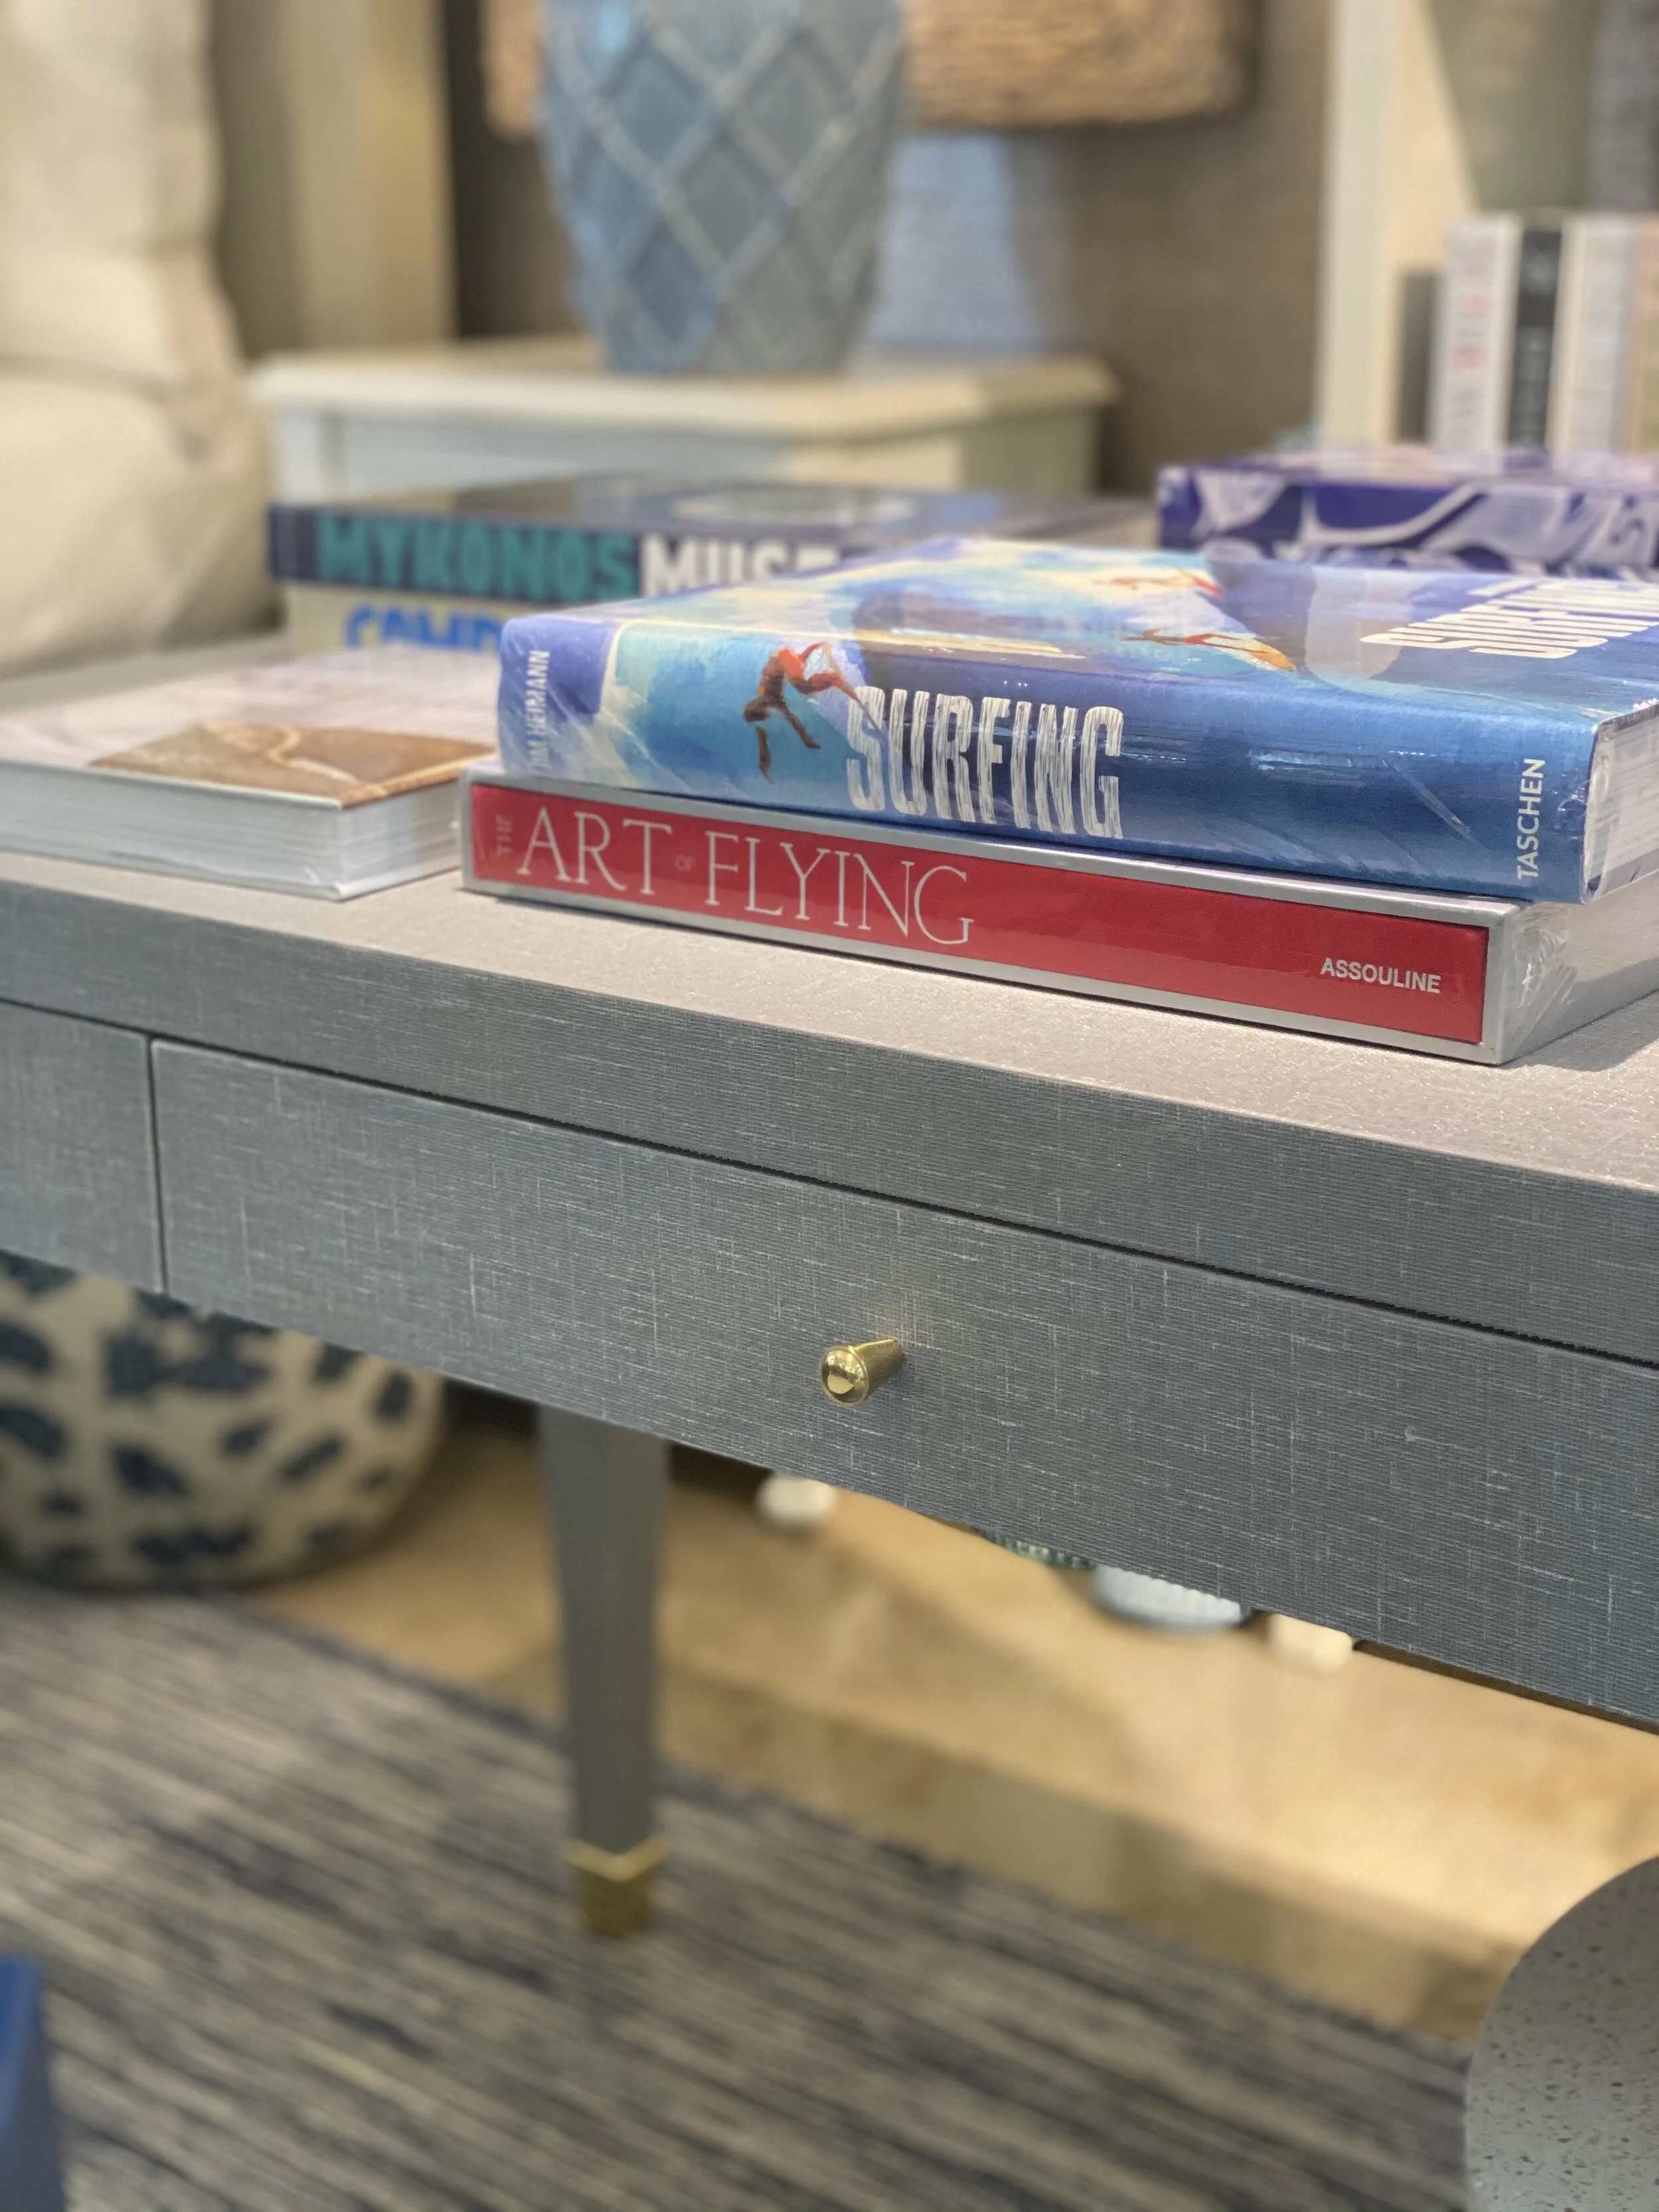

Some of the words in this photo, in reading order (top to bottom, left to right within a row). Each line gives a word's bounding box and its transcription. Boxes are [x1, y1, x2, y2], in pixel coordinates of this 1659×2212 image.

[316, 513, 636, 602] MYKONOS
[845, 685, 1123, 840] SURFING
[1516, 758, 1546, 881] TASCHEN
[515, 805, 673, 896] ART
[704, 830, 975, 945] FLYING
[1320, 956, 1442, 994] ASSOULINE
